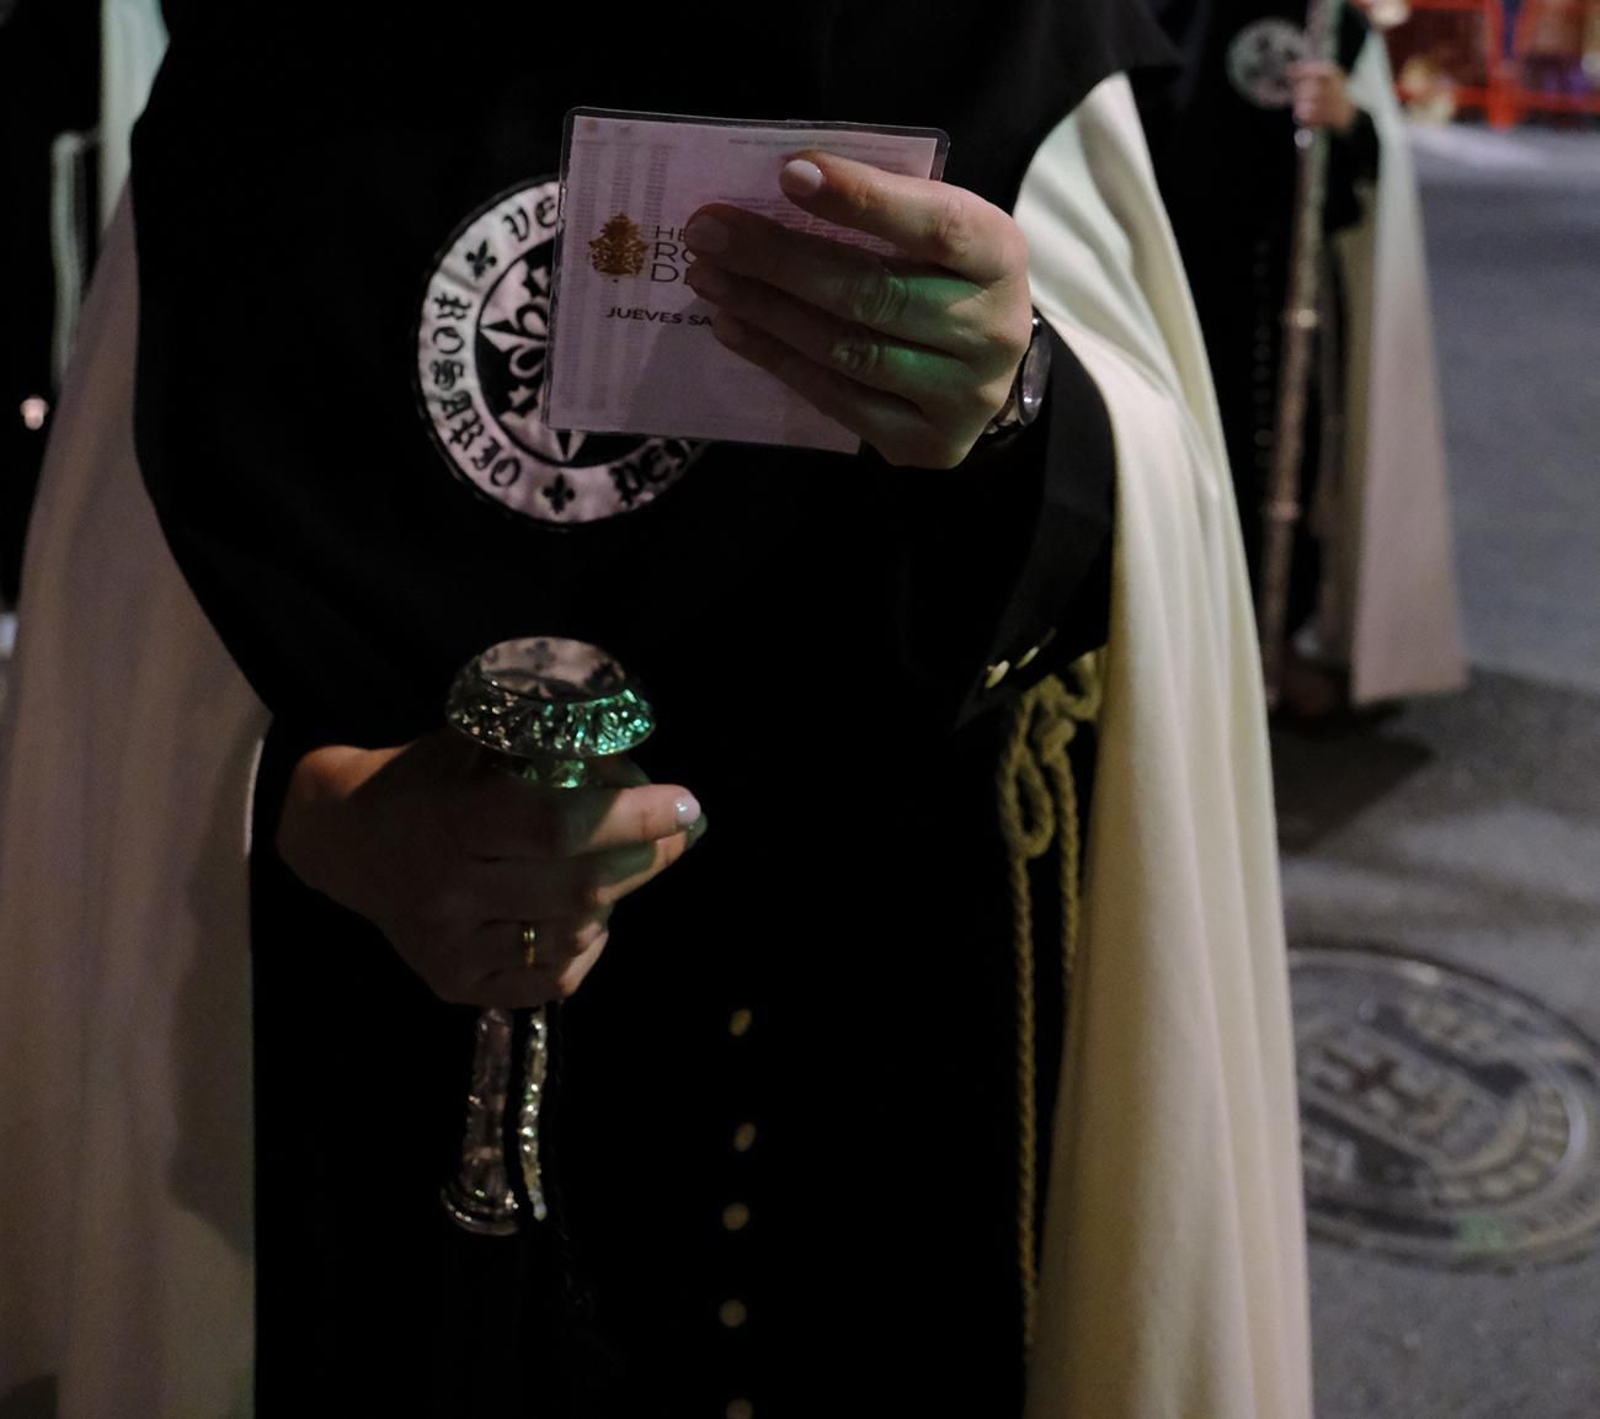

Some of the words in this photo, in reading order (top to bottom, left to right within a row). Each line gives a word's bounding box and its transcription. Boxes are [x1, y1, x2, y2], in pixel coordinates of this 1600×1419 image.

[607, 306, 683, 324] JUEVES
[686, 313, 713, 327] SA
[432, 293, 522, 488] ROSARIO
